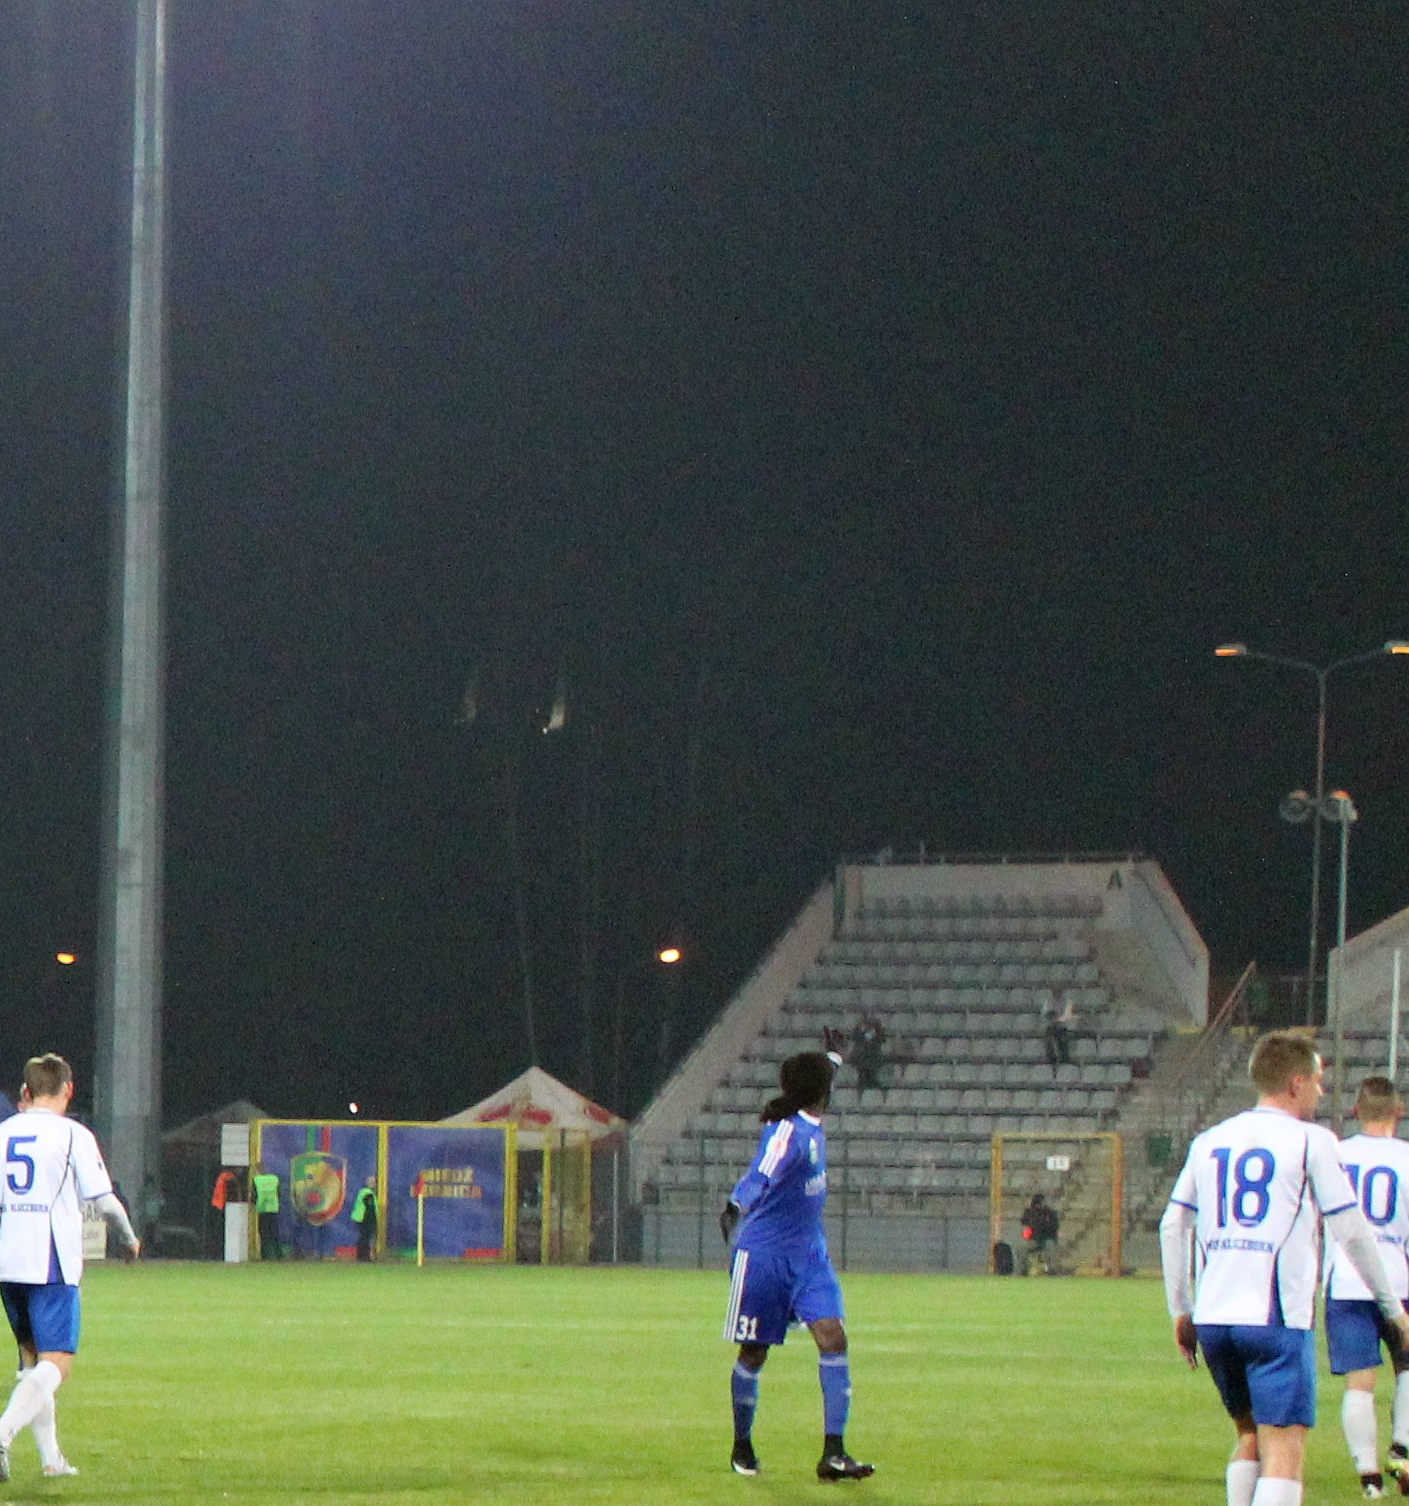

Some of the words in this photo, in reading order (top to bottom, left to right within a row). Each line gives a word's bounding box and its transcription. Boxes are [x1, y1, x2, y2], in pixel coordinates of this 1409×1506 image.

[6, 1135, 37, 1196] 5
[1210, 1147, 1276, 1229] 18
[735, 1314, 758, 1341] 31
